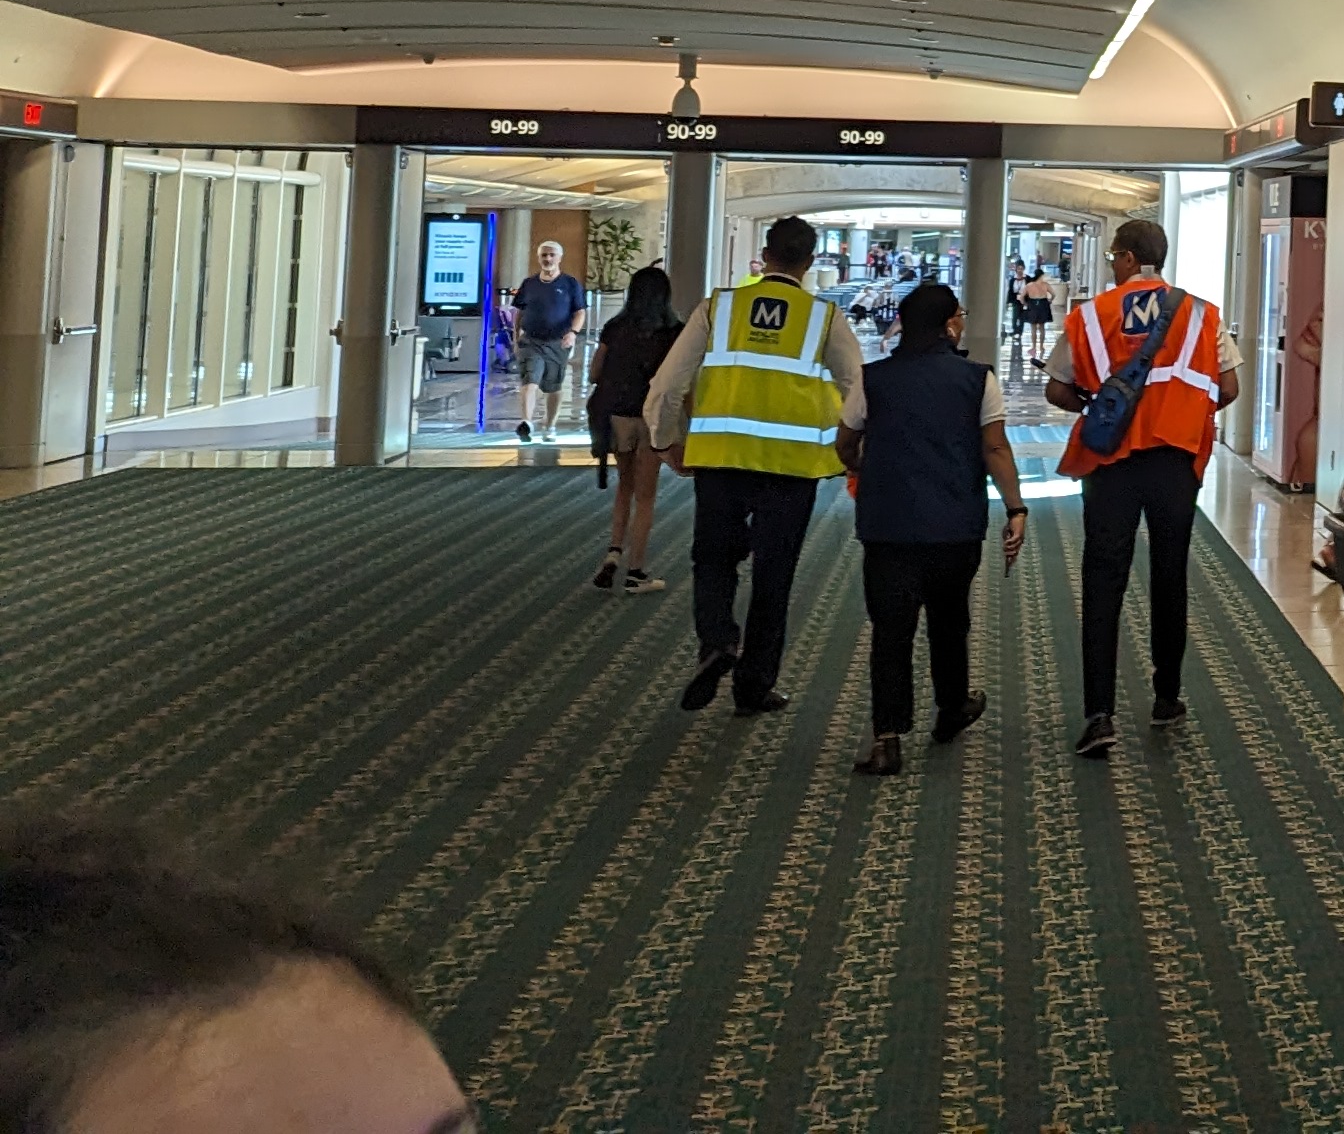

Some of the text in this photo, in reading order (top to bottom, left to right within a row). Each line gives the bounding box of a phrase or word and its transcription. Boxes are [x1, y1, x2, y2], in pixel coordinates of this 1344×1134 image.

[490, 119, 539, 136] 90-99
[666, 123, 717, 140] 90-99
[839, 129, 885, 146] 90-99
[753, 302, 780, 327] M
[1124, 291, 1160, 329] M
